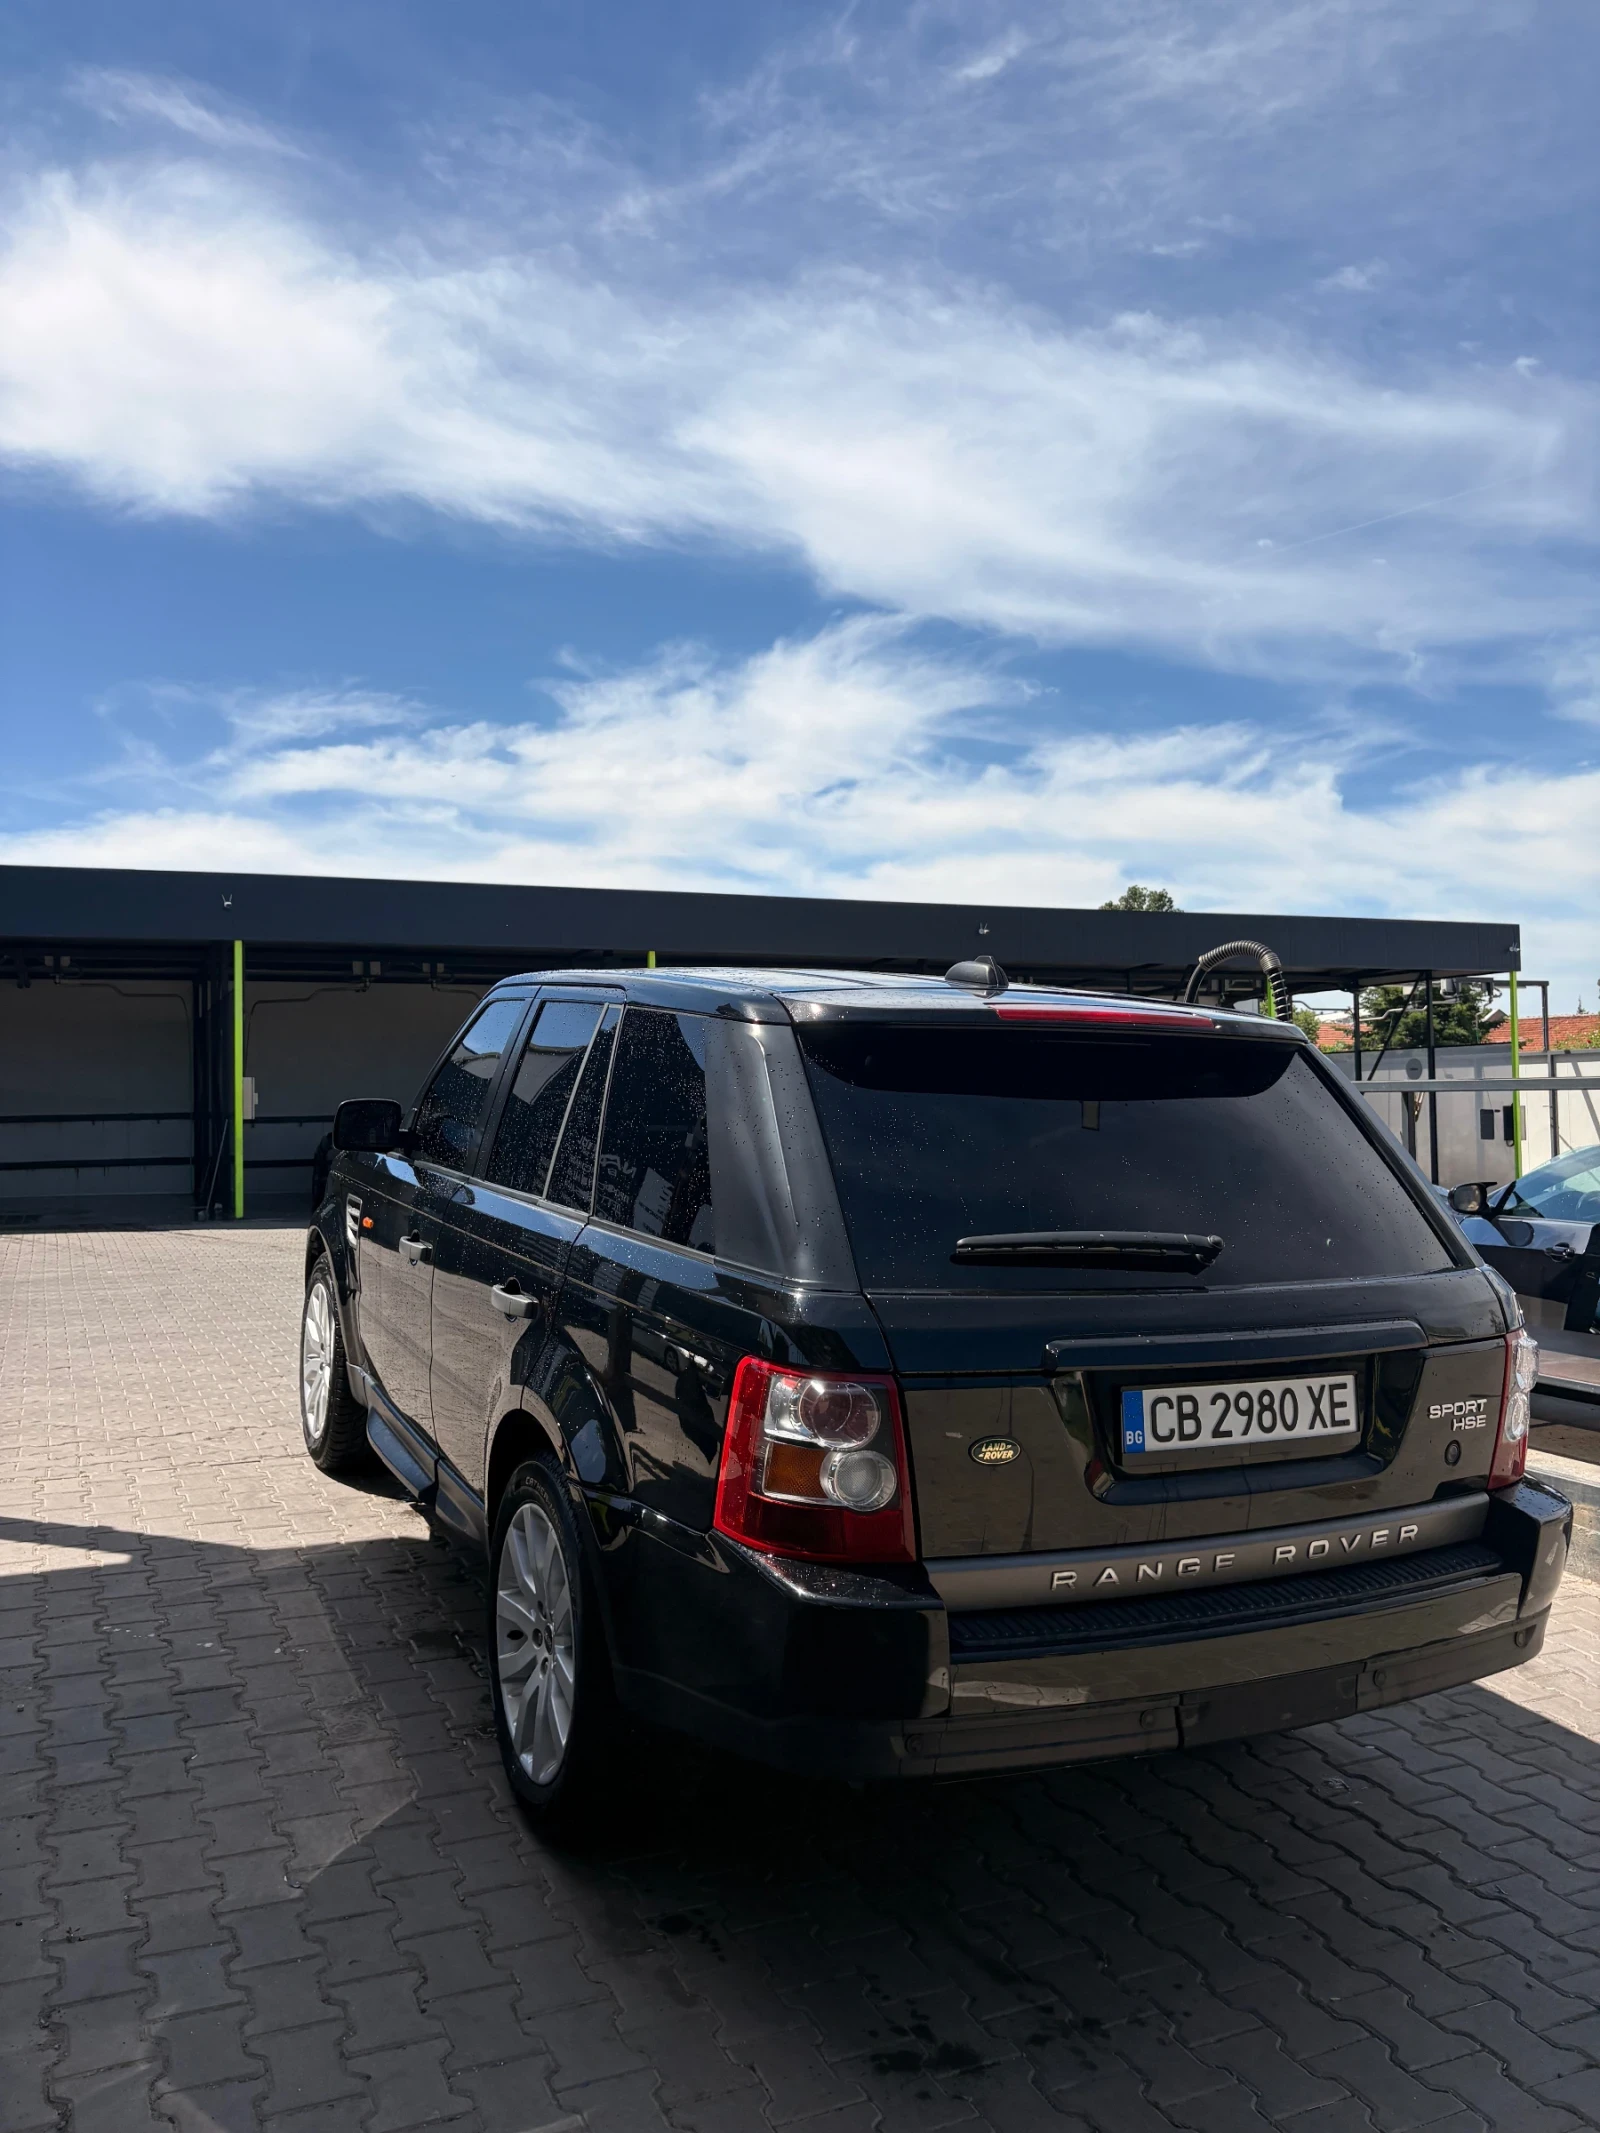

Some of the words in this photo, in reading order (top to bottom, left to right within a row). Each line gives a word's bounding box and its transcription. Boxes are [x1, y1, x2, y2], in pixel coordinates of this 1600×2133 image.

[1150, 1394, 1202, 1443] CB
[1210, 1387, 1299, 1439] 2980
[1306, 1382, 1351, 1430] XE
[1428, 1398, 1488, 1419] SPORT
[1452, 1414, 1487, 1432] HSE
[981, 1442, 1006, 1452] LAND
[1126, 1430, 1143, 1446] BG
[983, 1450, 1014, 1460] ROVER
[1051, 1553, 1236, 1591] RANGE
[1272, 1524, 1419, 1566] ROVER
